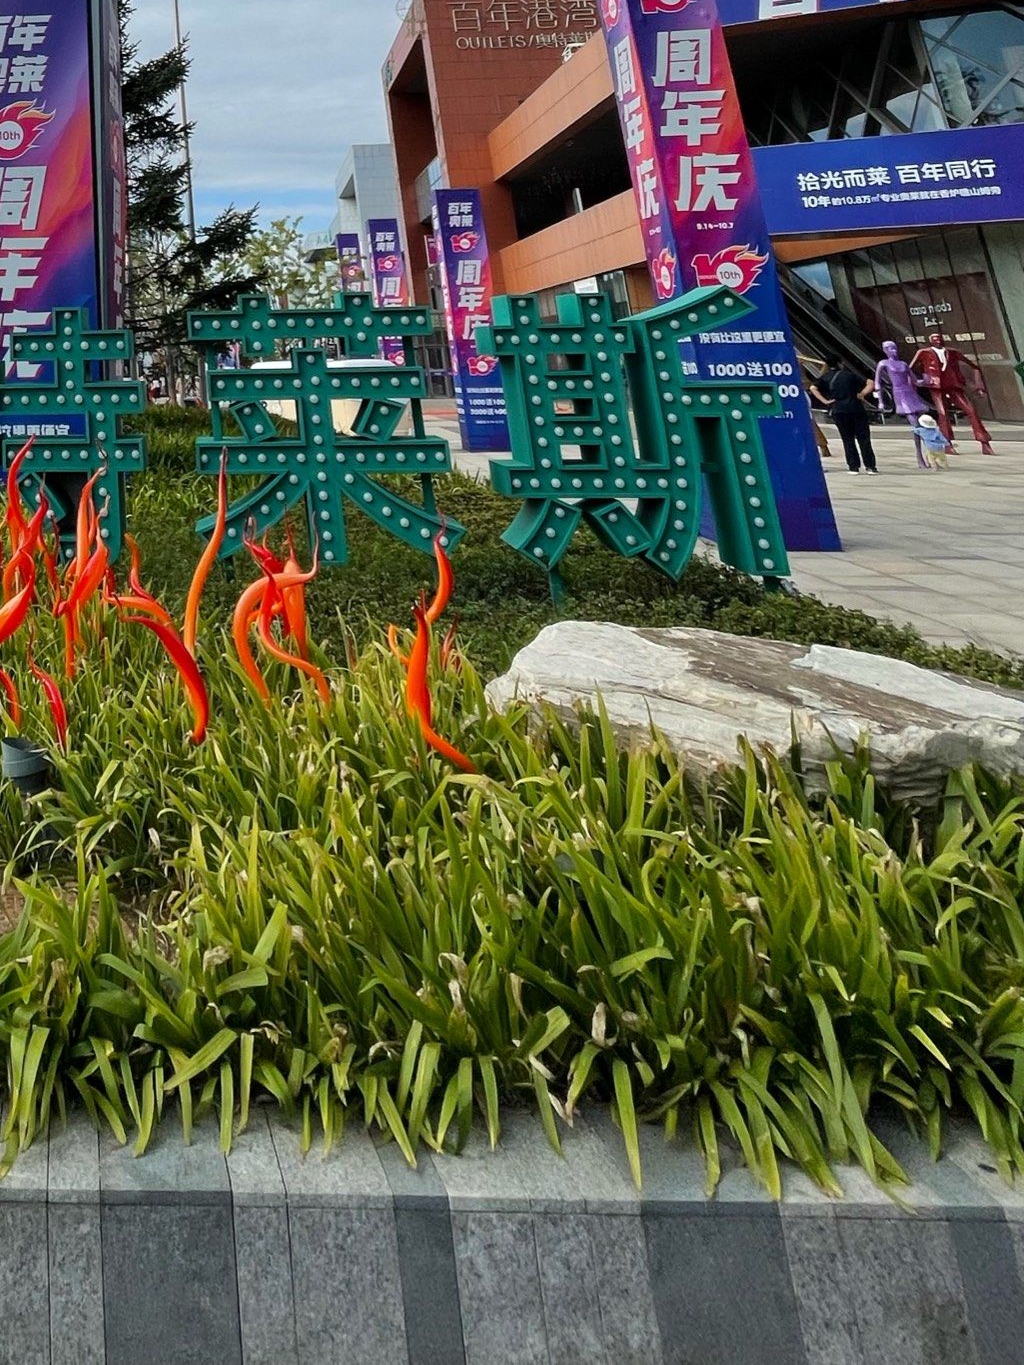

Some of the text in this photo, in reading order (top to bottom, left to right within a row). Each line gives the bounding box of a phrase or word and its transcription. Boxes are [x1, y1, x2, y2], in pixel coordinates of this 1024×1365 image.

[651, 28, 742, 212] 周年庆
[613, 36, 661, 220] 周年庆
[797, 158, 996, 192] 拾光而莱 百年同行
[447, 202, 473, 215] 百年
[719, 271, 741, 280] 10th
[698, 331, 786, 344] 没有比这里更便宜
[708, 362, 793, 377] 1000送100
